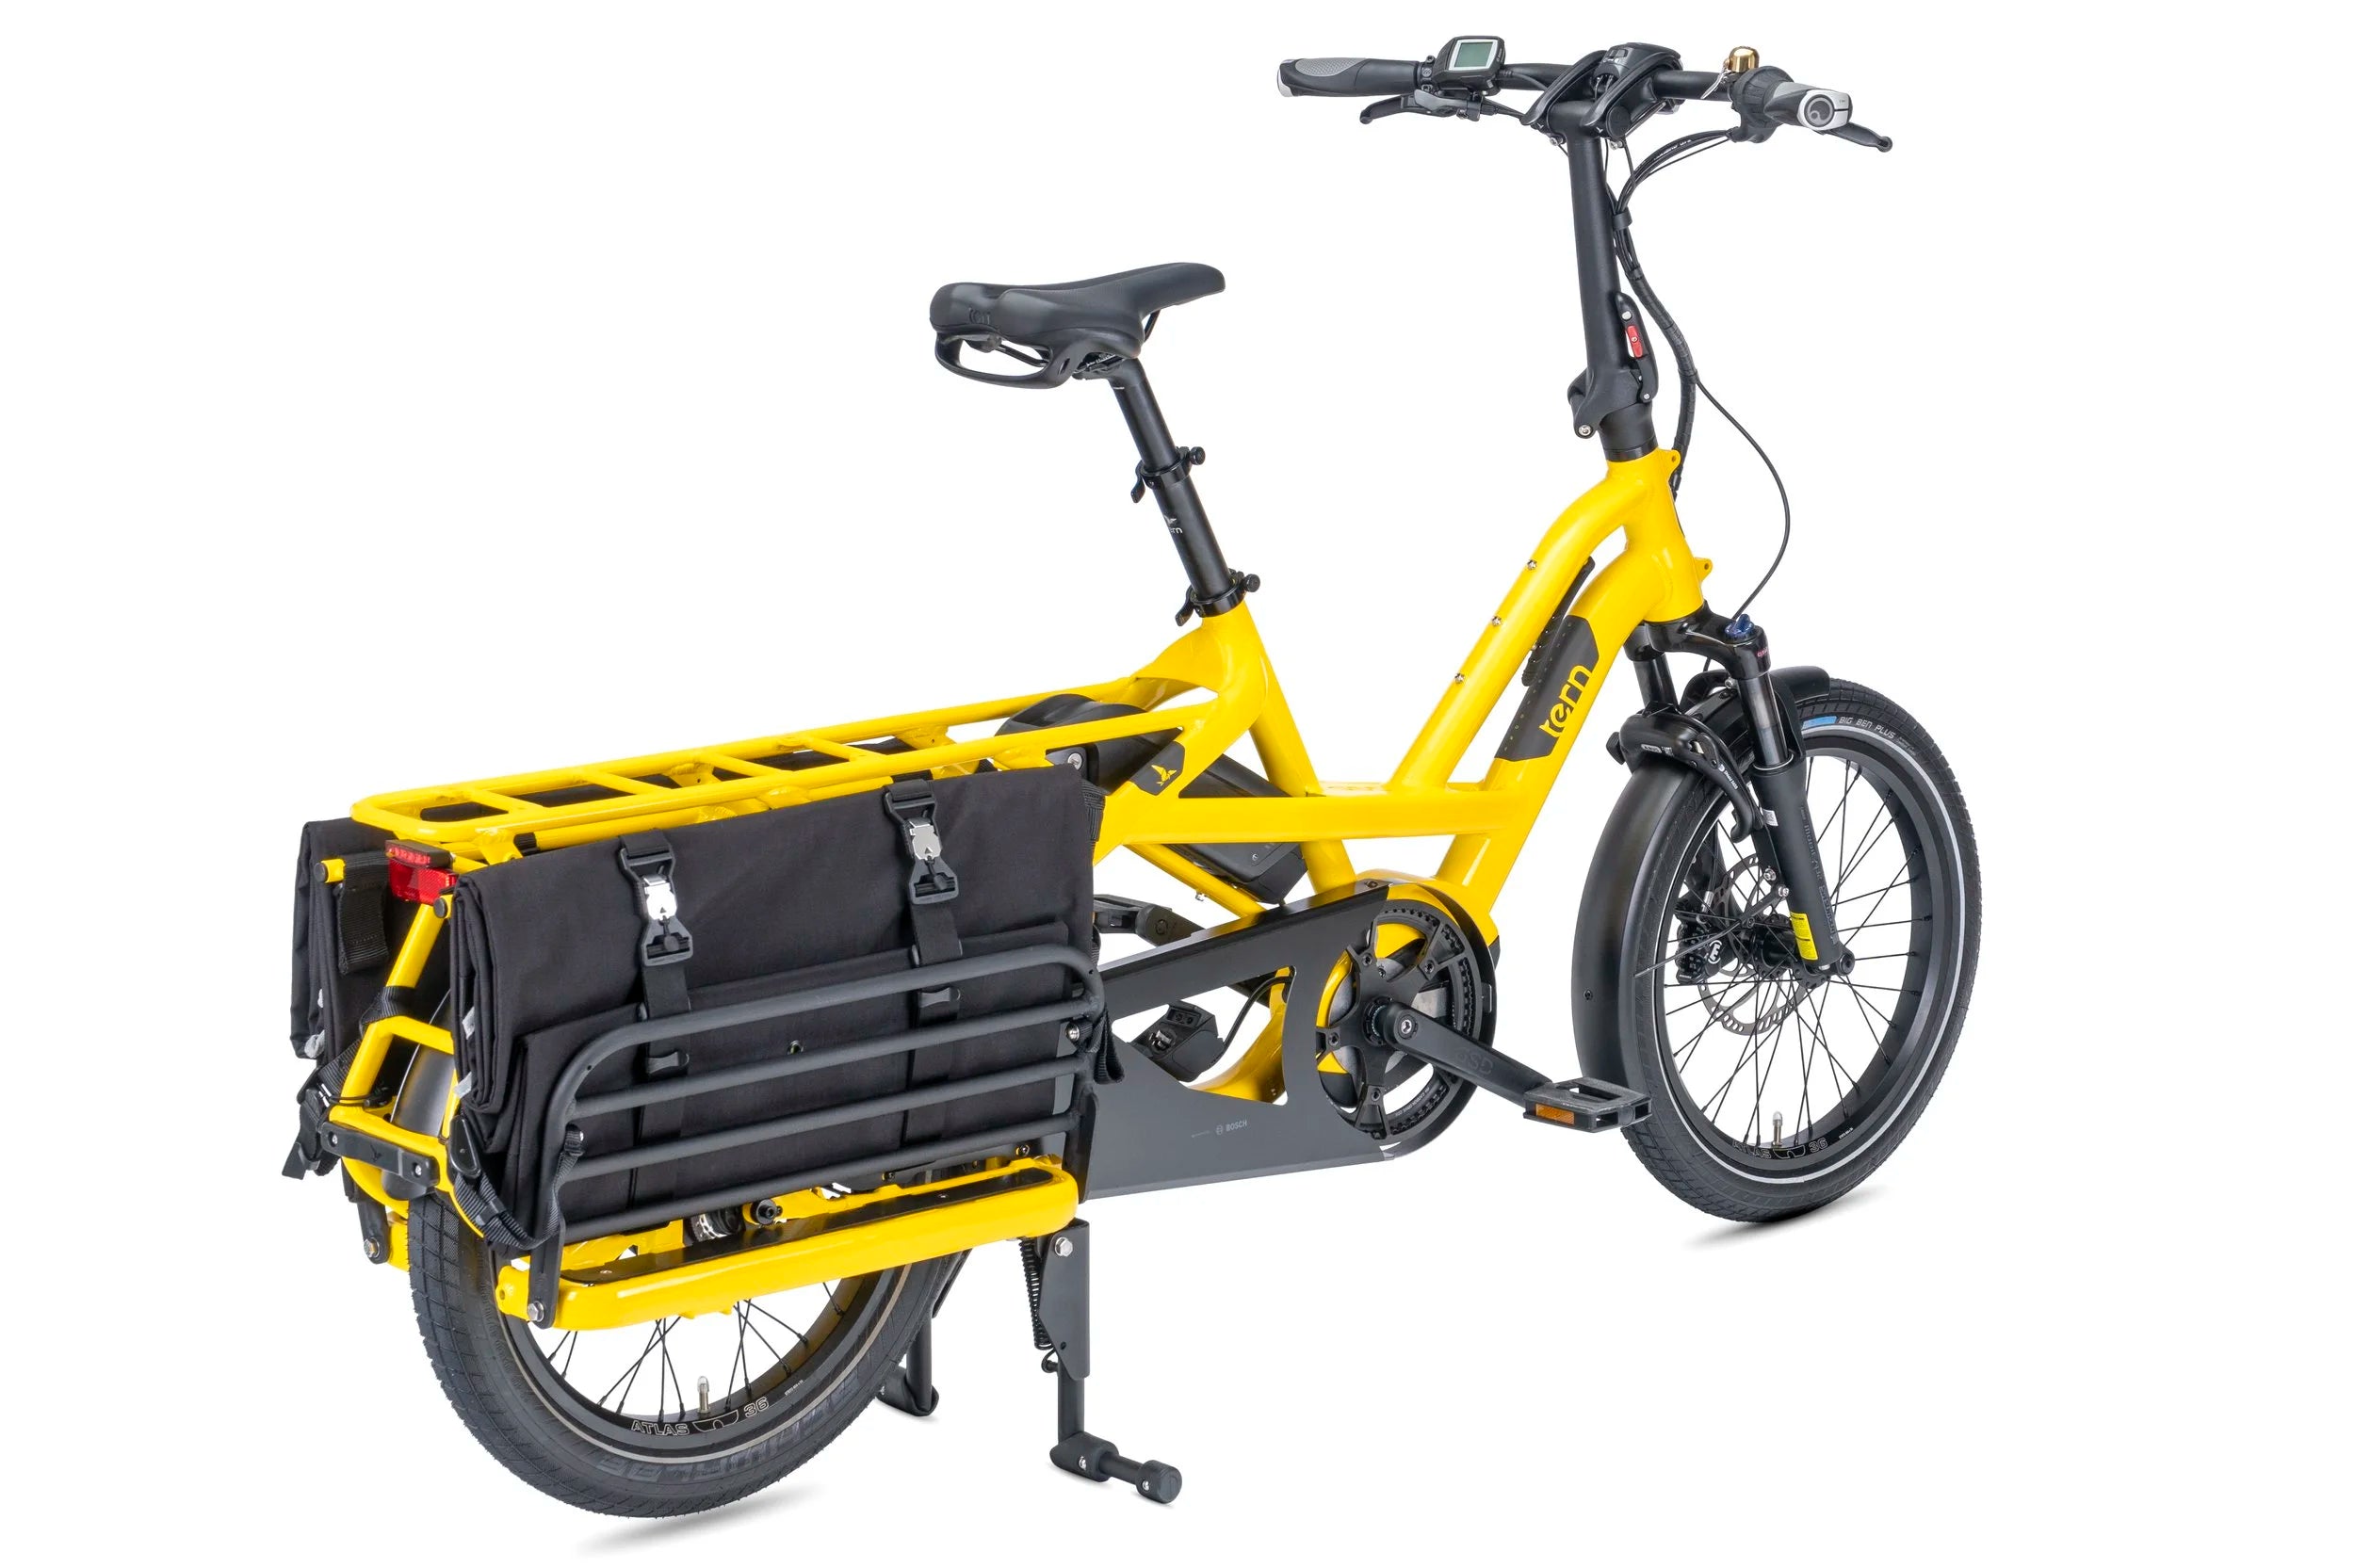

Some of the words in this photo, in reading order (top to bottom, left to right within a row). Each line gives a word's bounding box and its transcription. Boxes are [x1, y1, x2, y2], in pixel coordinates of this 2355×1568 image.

[1539, 665, 1593, 738] tern
[1838, 717, 1854, 725] BIG
[1856, 719, 1873, 729] BEN
[1874, 724, 1896, 739] PLUS
[1226, 1119, 1248, 1132] BOSCH
[1808, 1137, 1828, 1154] 36
[630, 1419, 690, 1436] ATLAS
[743, 1396, 771, 1418] 36
